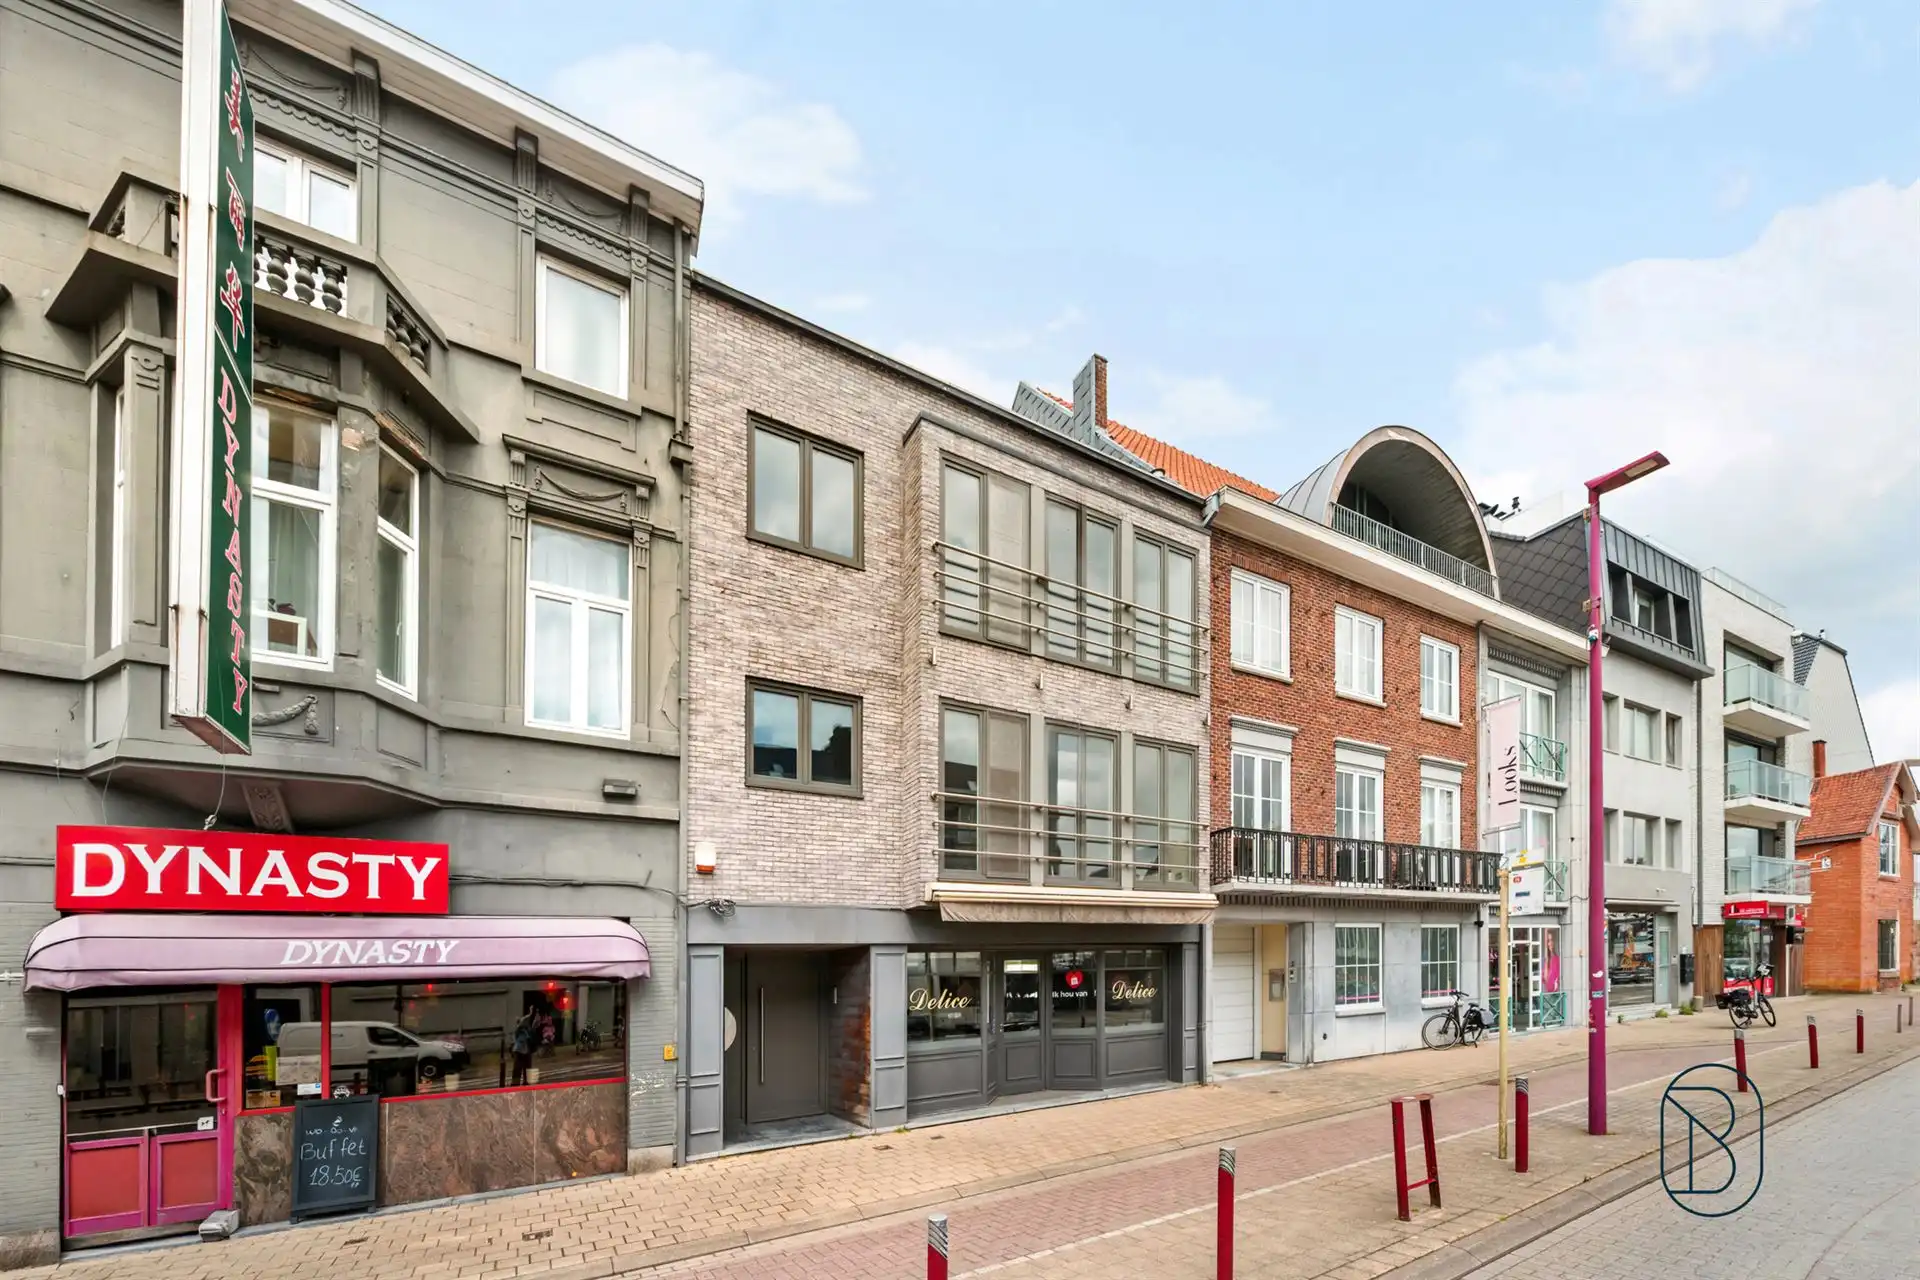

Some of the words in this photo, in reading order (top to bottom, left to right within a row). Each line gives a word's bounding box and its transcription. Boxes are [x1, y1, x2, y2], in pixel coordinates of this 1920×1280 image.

[217, 365, 249, 717] DYNASTY
[1497, 745, 1518, 806] Looks
[71, 841, 442, 901] DYNASTY
[280, 938, 459, 966] DYNASTY
[908, 986, 973, 1012] Delice
[1111, 980, 1158, 1002] Delice
